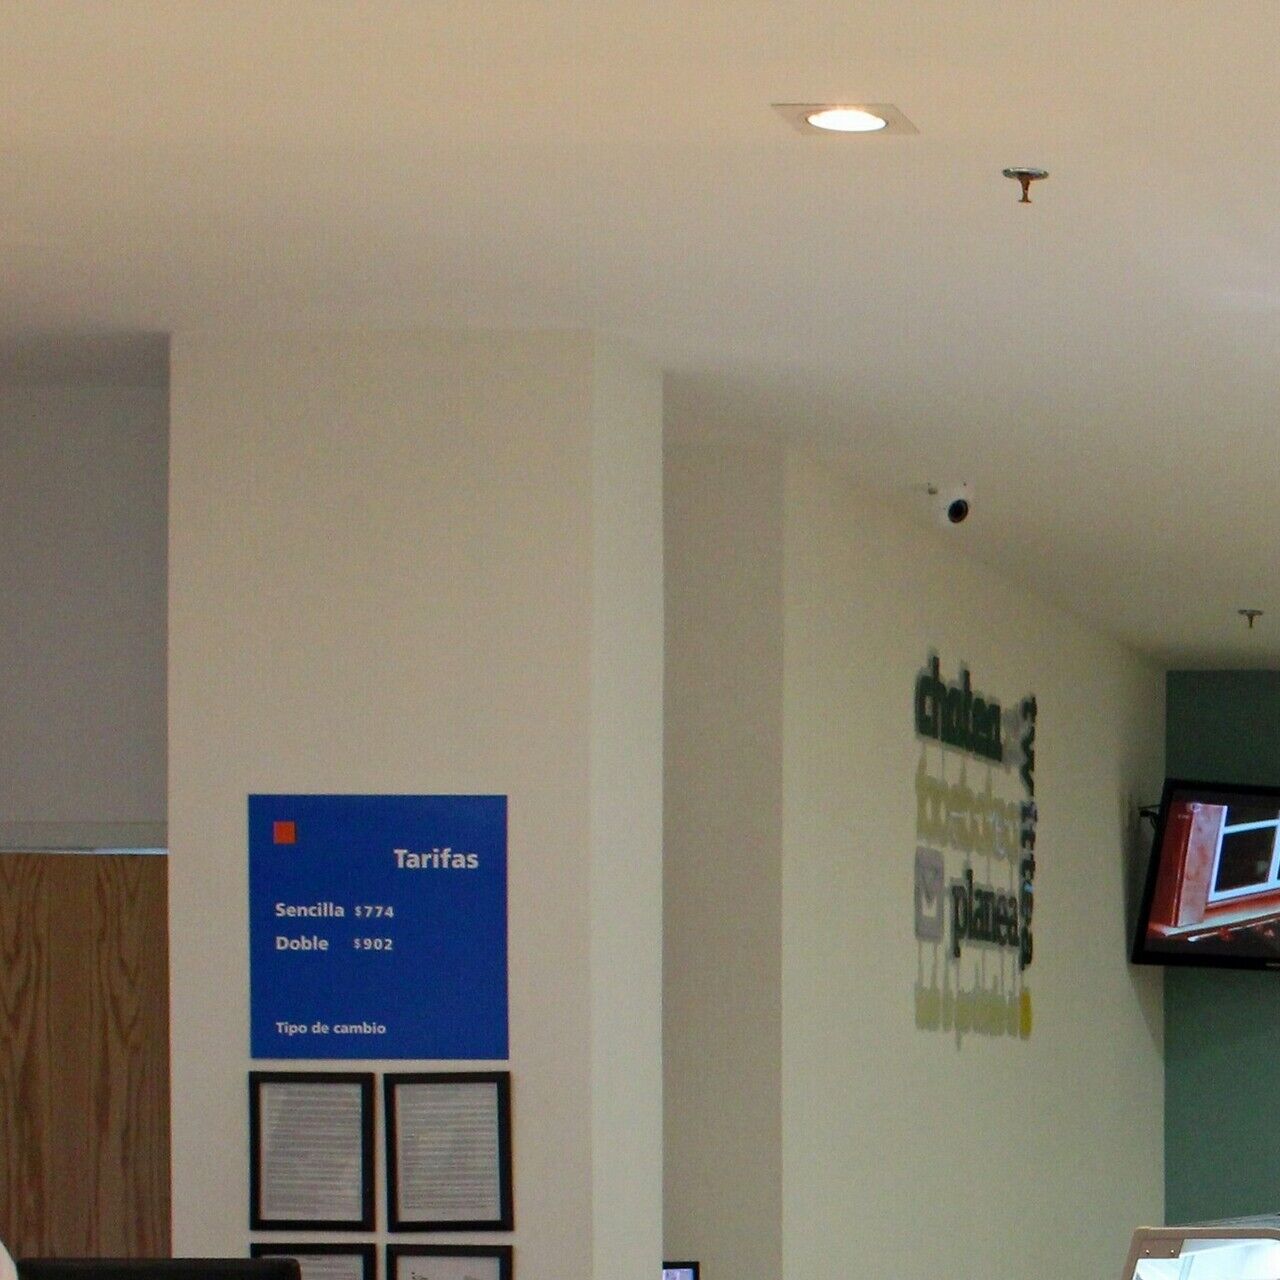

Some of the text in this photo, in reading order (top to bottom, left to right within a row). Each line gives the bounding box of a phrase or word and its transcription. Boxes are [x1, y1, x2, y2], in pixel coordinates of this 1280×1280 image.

[393, 847, 479, 869] Tarifas
[275, 902, 395, 919] Sencilla $774
[275, 935, 394, 951] Doble $902
[275, 1021, 387, 1036] Tipo de cambio
